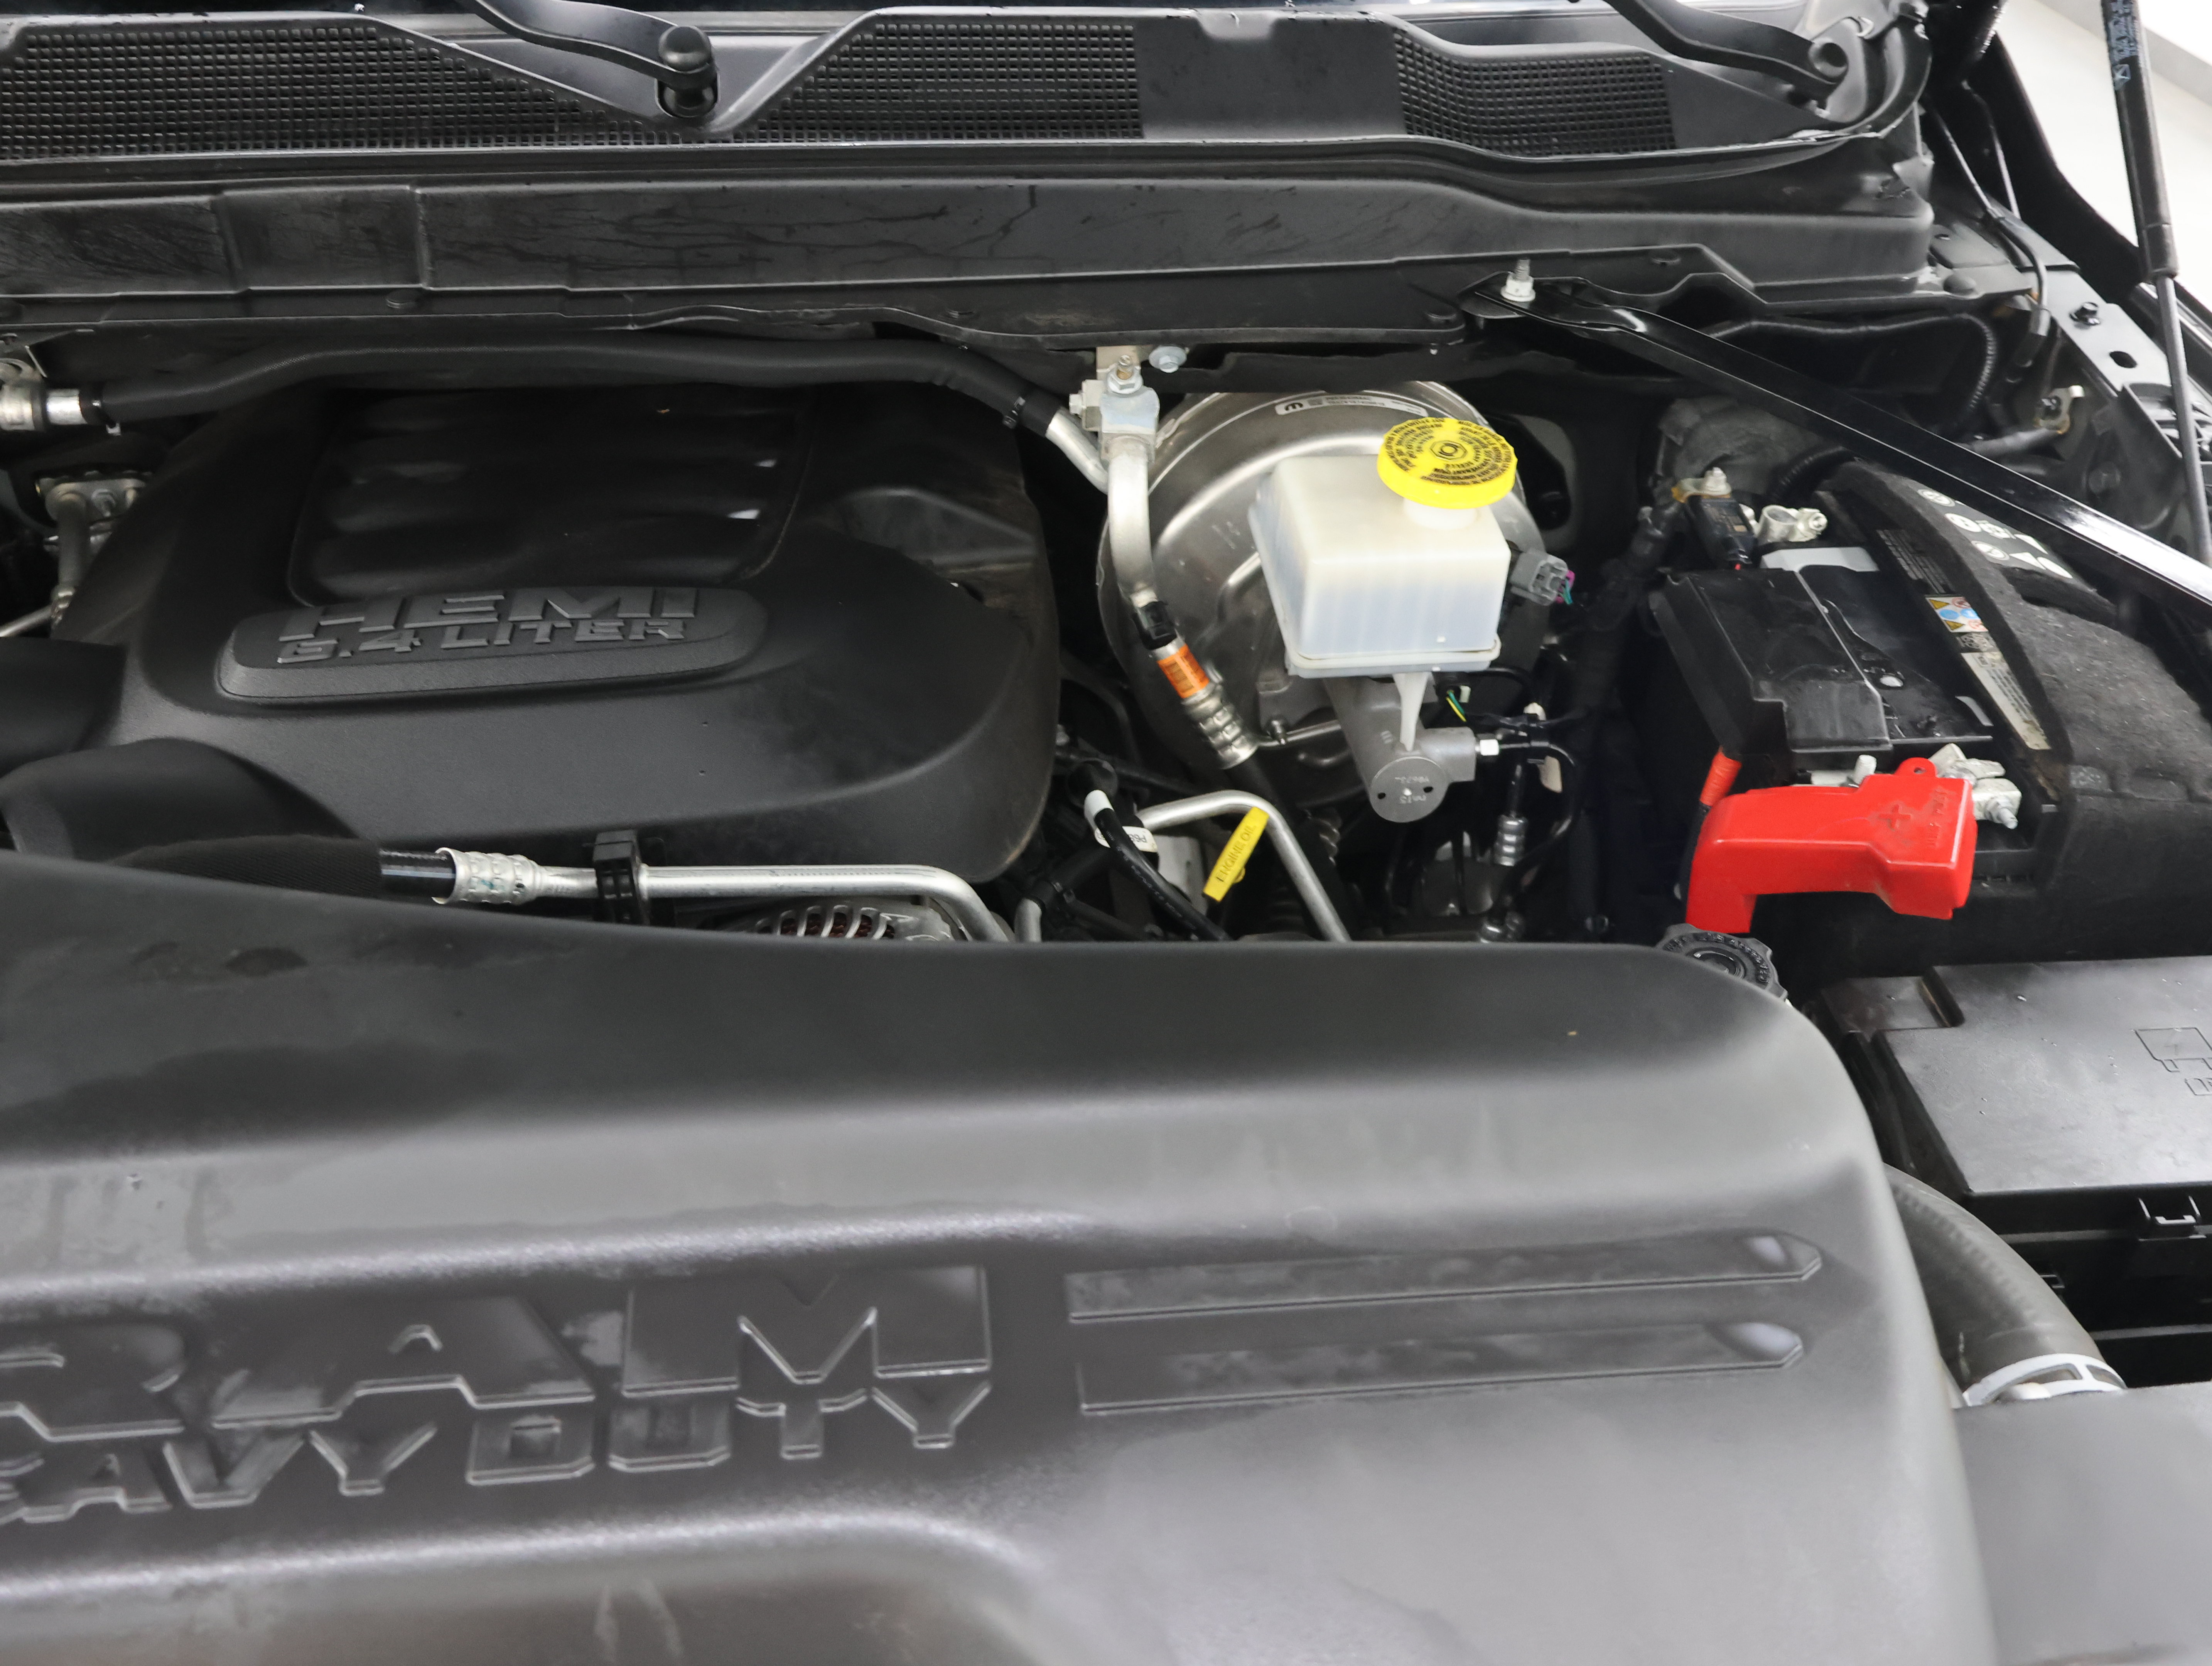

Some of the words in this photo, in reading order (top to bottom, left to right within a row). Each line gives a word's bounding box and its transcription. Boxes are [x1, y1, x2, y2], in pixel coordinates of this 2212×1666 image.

[277, 629, 422, 664] 6.4
[440, 618, 686, 649] LITER
[278, 587, 696, 642] HEMI
[1215, 840, 1247, 883] ENGINE
[1240, 825, 1257, 842] OIL
[465, 1381, 993, 1486] DUTY
